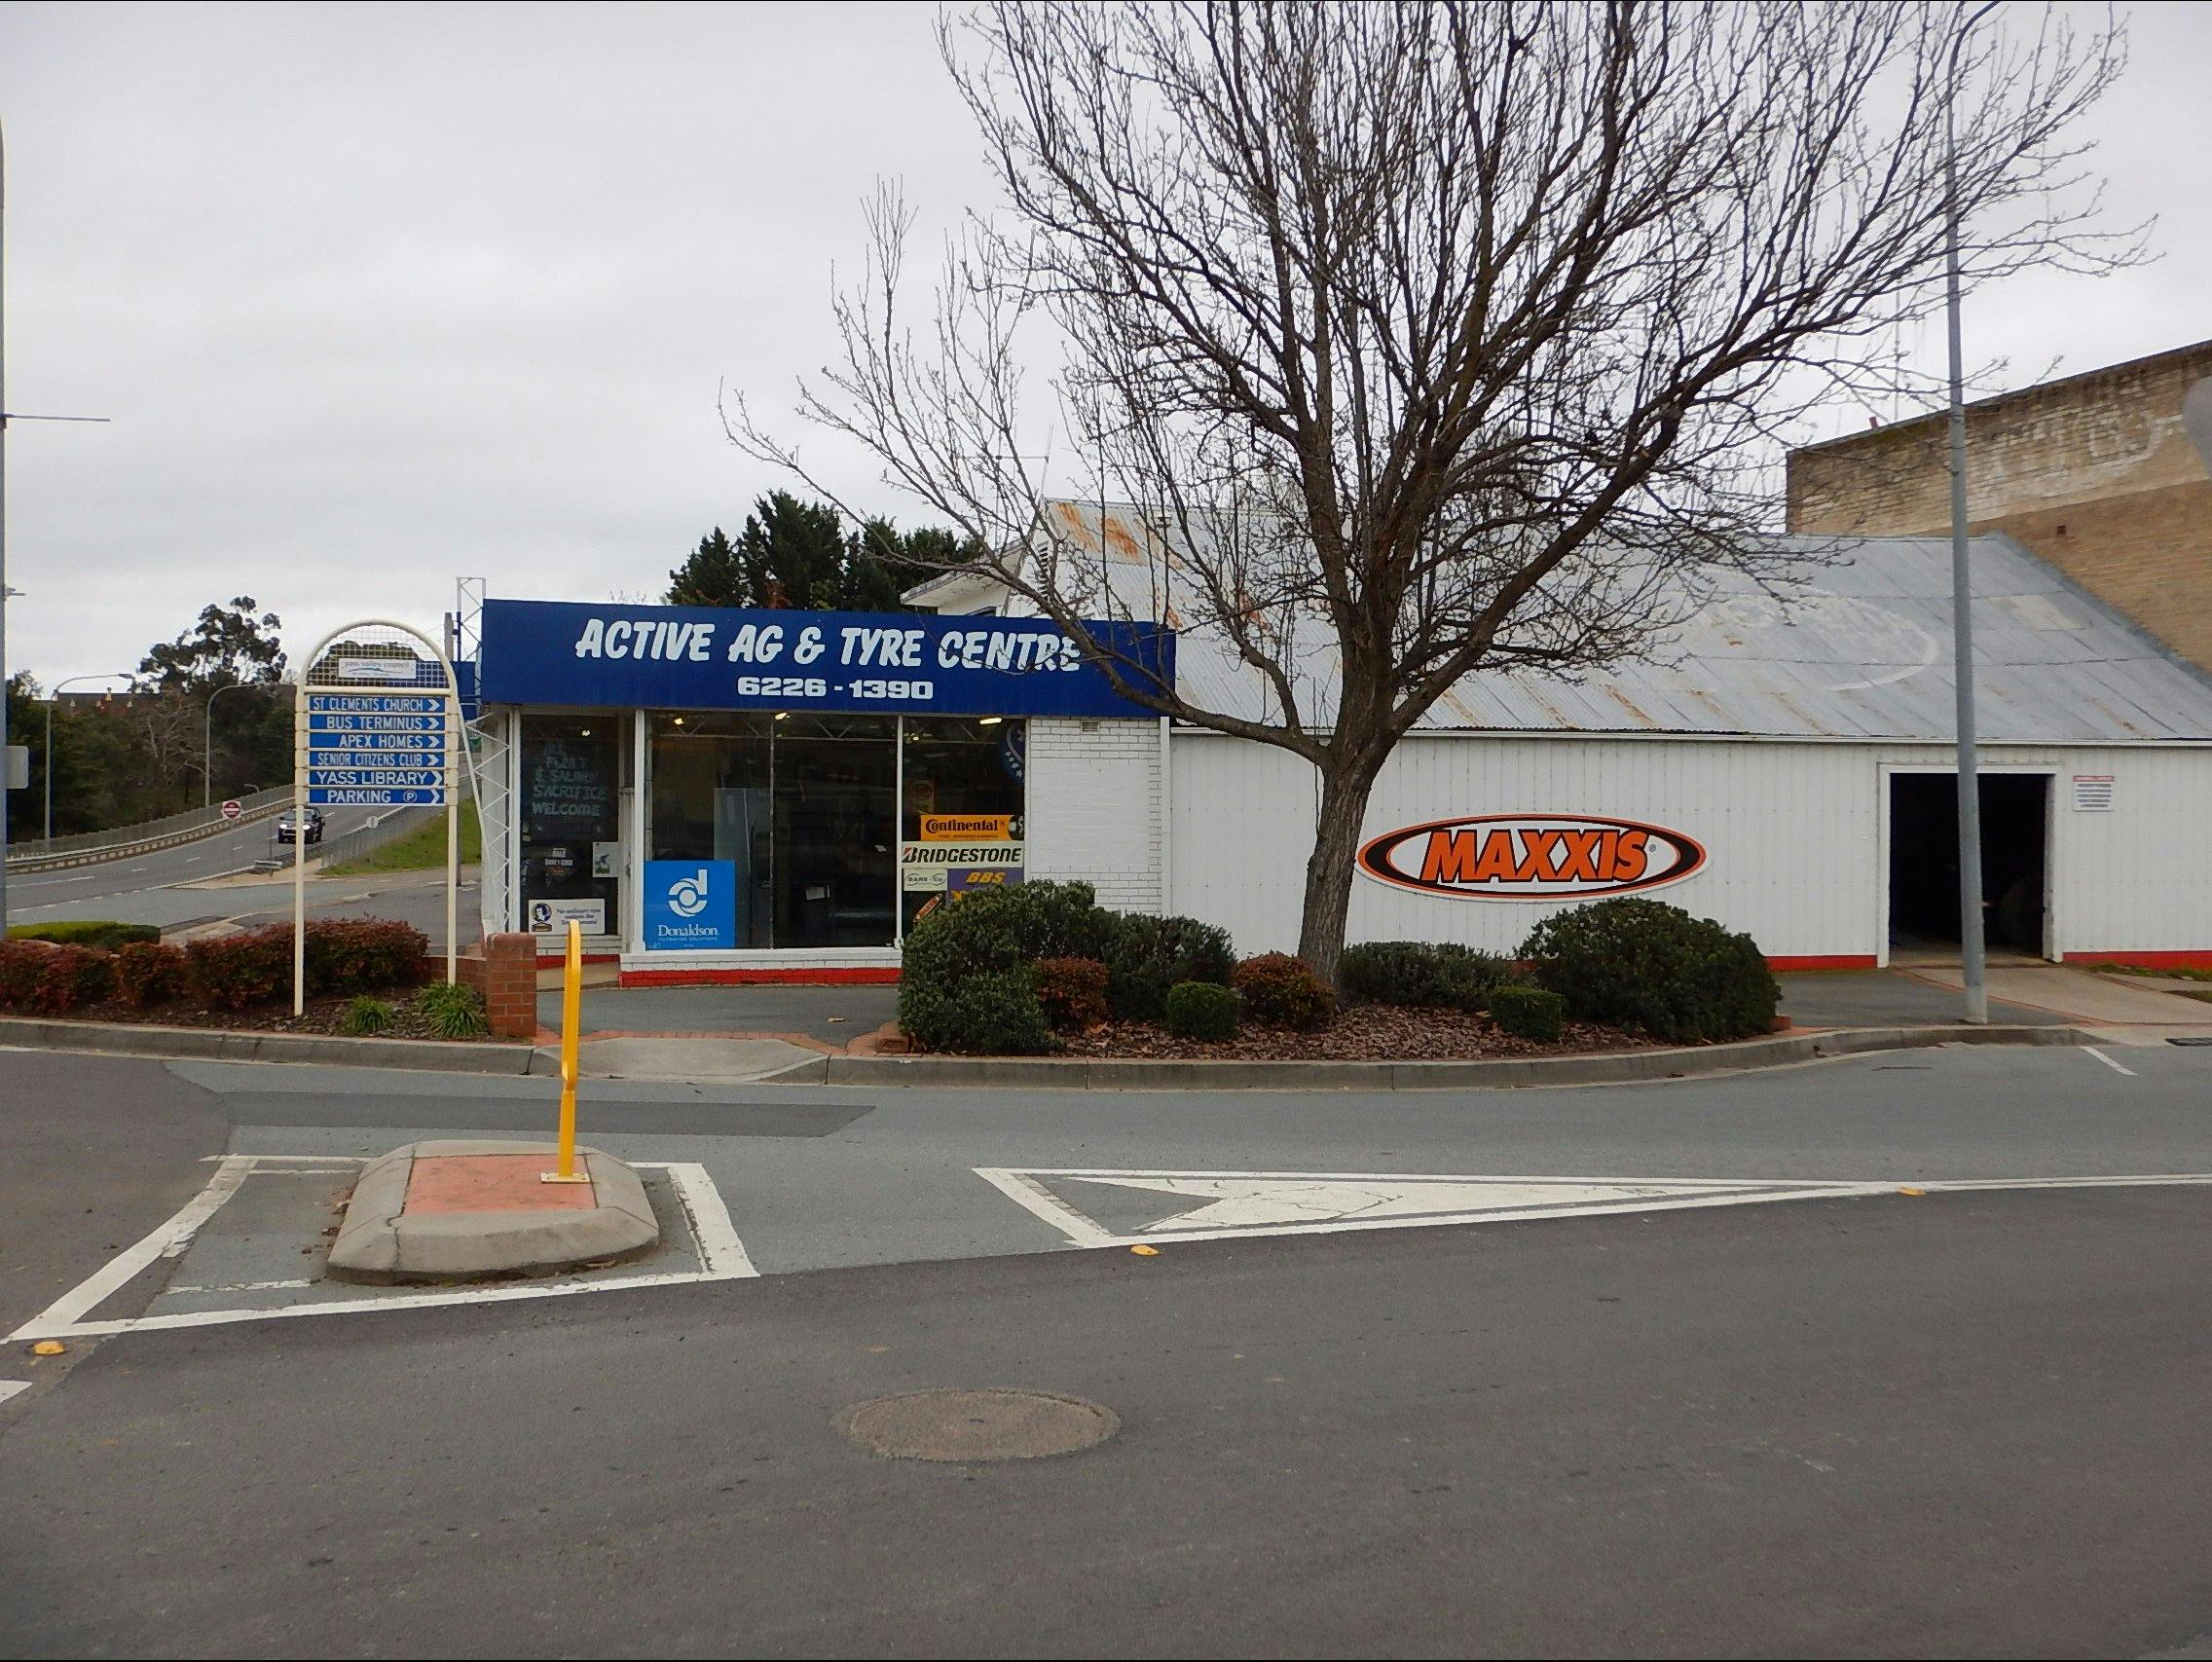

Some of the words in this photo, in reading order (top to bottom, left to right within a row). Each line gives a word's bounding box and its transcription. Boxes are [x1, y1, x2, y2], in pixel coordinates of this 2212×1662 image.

[575, 618, 716, 662] ACTIVE
[727, 624, 784, 663] AG
[793, 626, 826, 665] &
[840, 627, 925, 668] TYRE
[938, 631, 1081, 672] CENTRE
[313, 697, 324, 711] ST
[329, 697, 379, 712] CLEMENTS
[384, 698, 424, 713] CHURCH
[326, 716, 353, 729] BUS
[358, 717, 423, 730] TERMINUS
[339, 734, 372, 748] APEX
[378, 735, 423, 749] HOMES
[317, 753, 351, 766] SENIOR
[355, 753, 395, 766] CITIZENS
[399, 753, 423, 766] CLUB
[316, 770, 356, 785] YASS
[361, 771, 428, 785] LIBRARY
[327, 790, 391, 803] PARKING
[925, 819, 998, 833] Continental
[902, 847, 1022, 864] BRIDGESTONE
[1419, 829, 1650, 883] MAXXIS
[965, 871, 1007, 884] BBS
[657, 924, 719, 937] Donaldson
